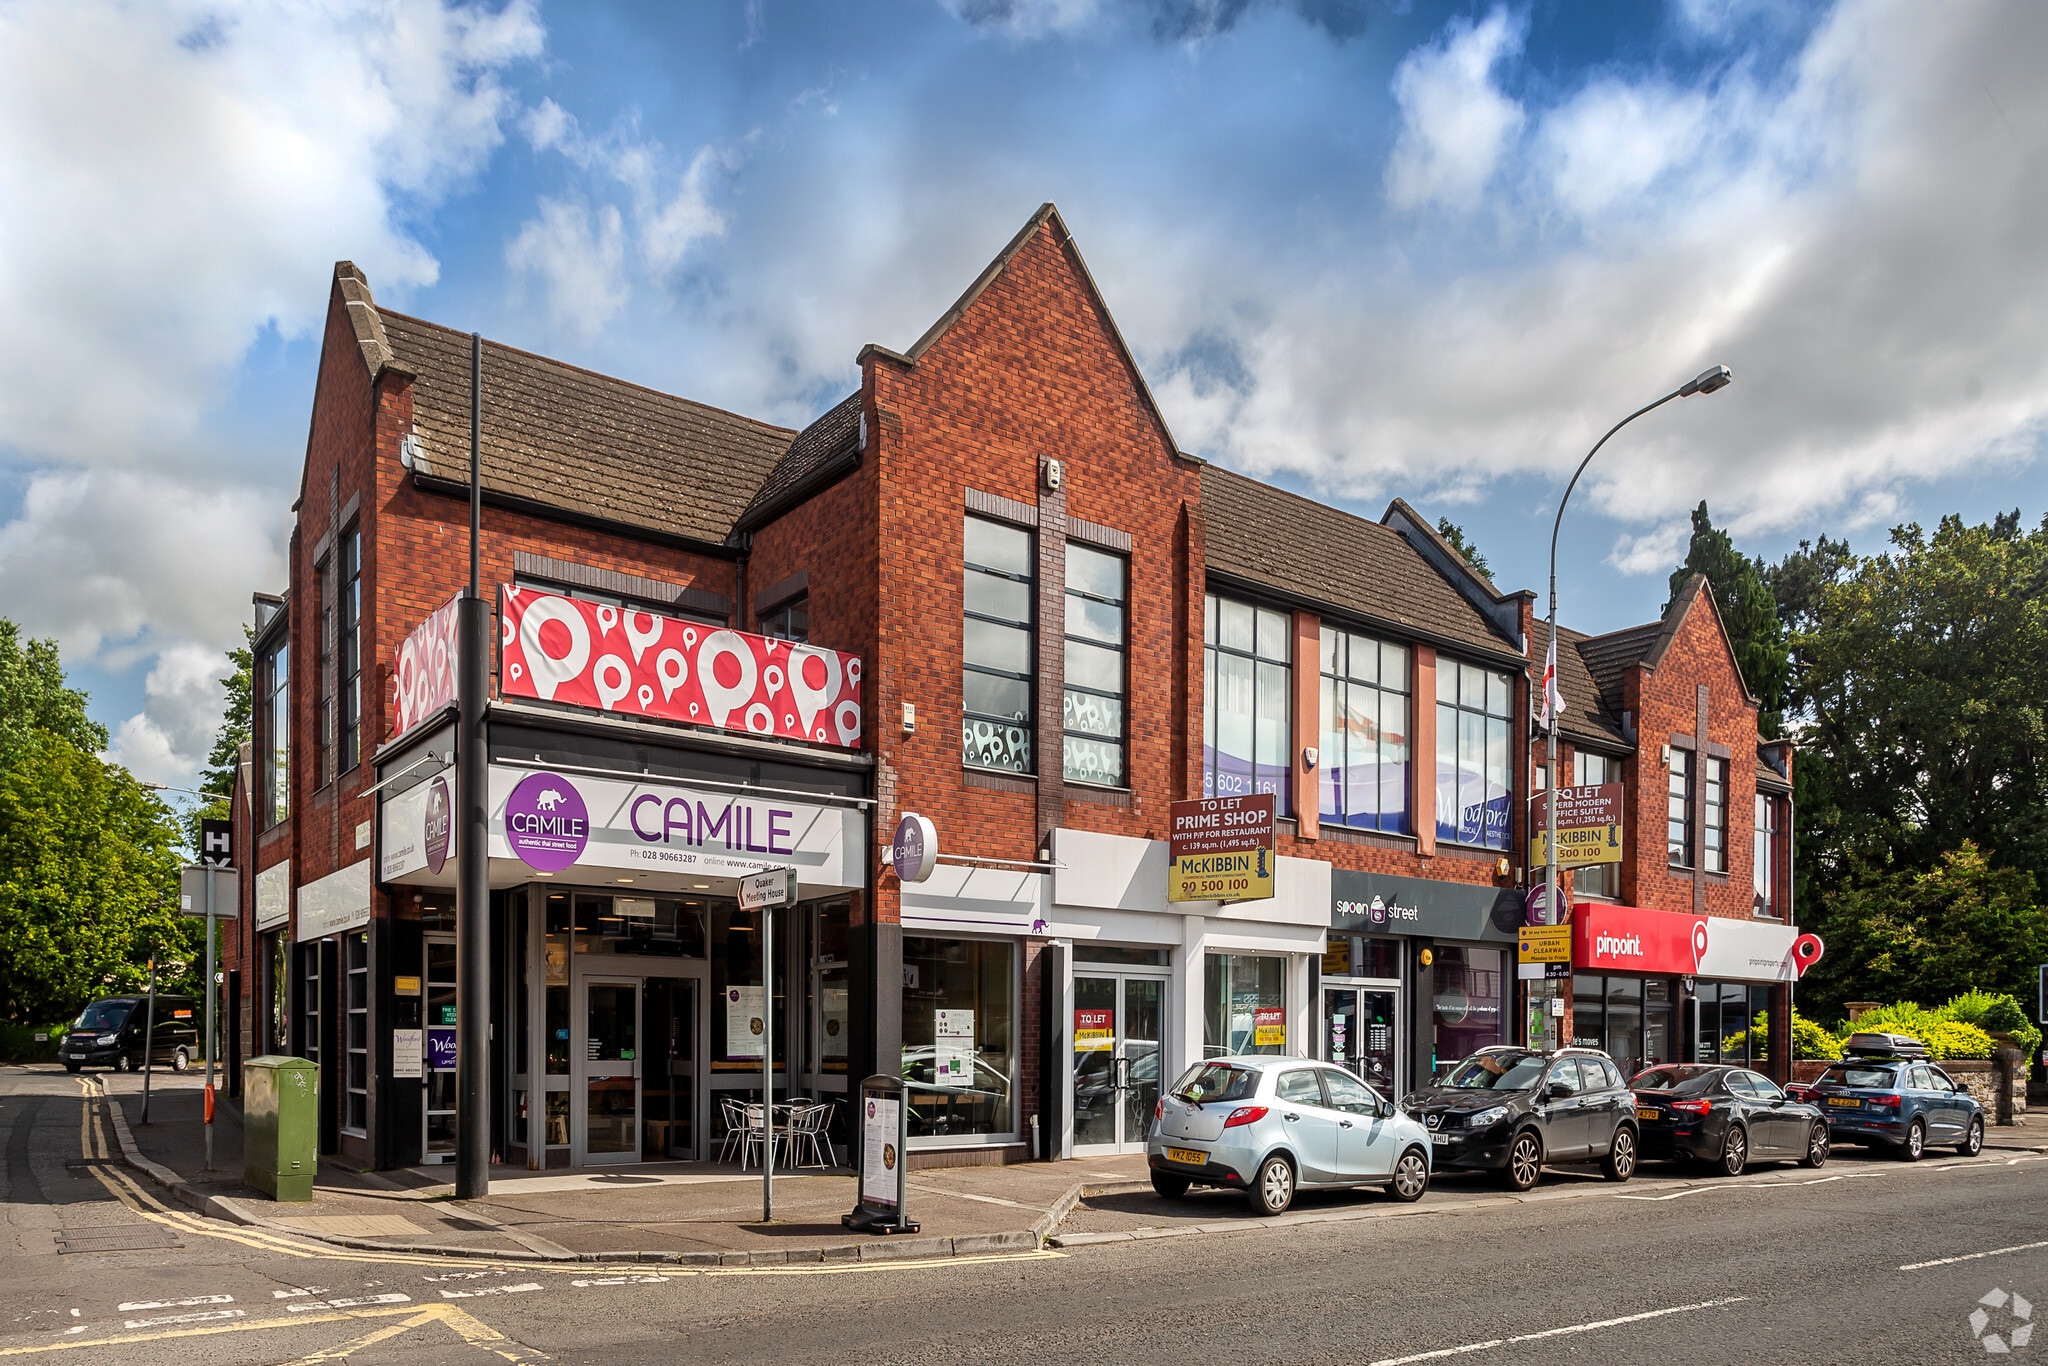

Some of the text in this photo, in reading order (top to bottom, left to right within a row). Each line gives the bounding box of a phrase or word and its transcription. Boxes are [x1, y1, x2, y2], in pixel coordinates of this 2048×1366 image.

[1217, 774, 1242, 793] 602
[1555, 786, 1602, 800] TO LET
[1200, 798, 1243, 811] TO LET
[1436, 772, 1511, 843] Woodford
[1542, 798, 1612, 810] SERB MODERN
[1579, 807, 1604, 815] SUITE
[512, 812, 584, 838] CAMILE
[630, 793, 794, 856] CAMILE
[1176, 809, 1268, 830] PRIME SHOP
[1557, 818, 1575, 827] sq.m.
[1575, 816, 1596, 825] (1,250
[1596, 815, 1616, 823] sq.ft.)
[425, 815, 448, 841] CAMILE
[1172, 826, 1272, 841] WITH P/P FOR RESTAURANT
[1487, 830, 1511, 840] AESTHETICS
[1189, 842, 1200, 850] 139
[1201, 842, 1219, 851] sq.m.
[1220, 839, 1240, 849] (1,495
[1240, 838, 1260, 847] sq.ft.)
[1542, 830, 1602, 845] KIBBIN
[630, 848, 642, 859] Ph:
[642, 850, 657, 860] 028
[659, 852, 697, 863] 90663287
[704, 856, 725, 866] online
[894, 843, 923, 860] CAMILE
[1559, 849, 1579, 858] 500
[1583, 847, 1601, 857] 100
[1181, 855, 1249, 874] McKIBBIN
[754, 877, 774, 888] Quaker
[1181, 878, 1249, 892] 90 500 100
[746, 888, 784, 903] Meeting House
[1336, 900, 1419, 921] spoon street
[1596, 930, 1644, 960] pinpoint.
[1081, 1014, 1107, 1023] TO LET
[1260, 1012, 1281, 1020] TO LET
[1078, 1031, 1105, 1039] McKIBBIN
[1582, 1038, 1599, 1046] moves
[1185, 1151, 1202, 1163] 1055
